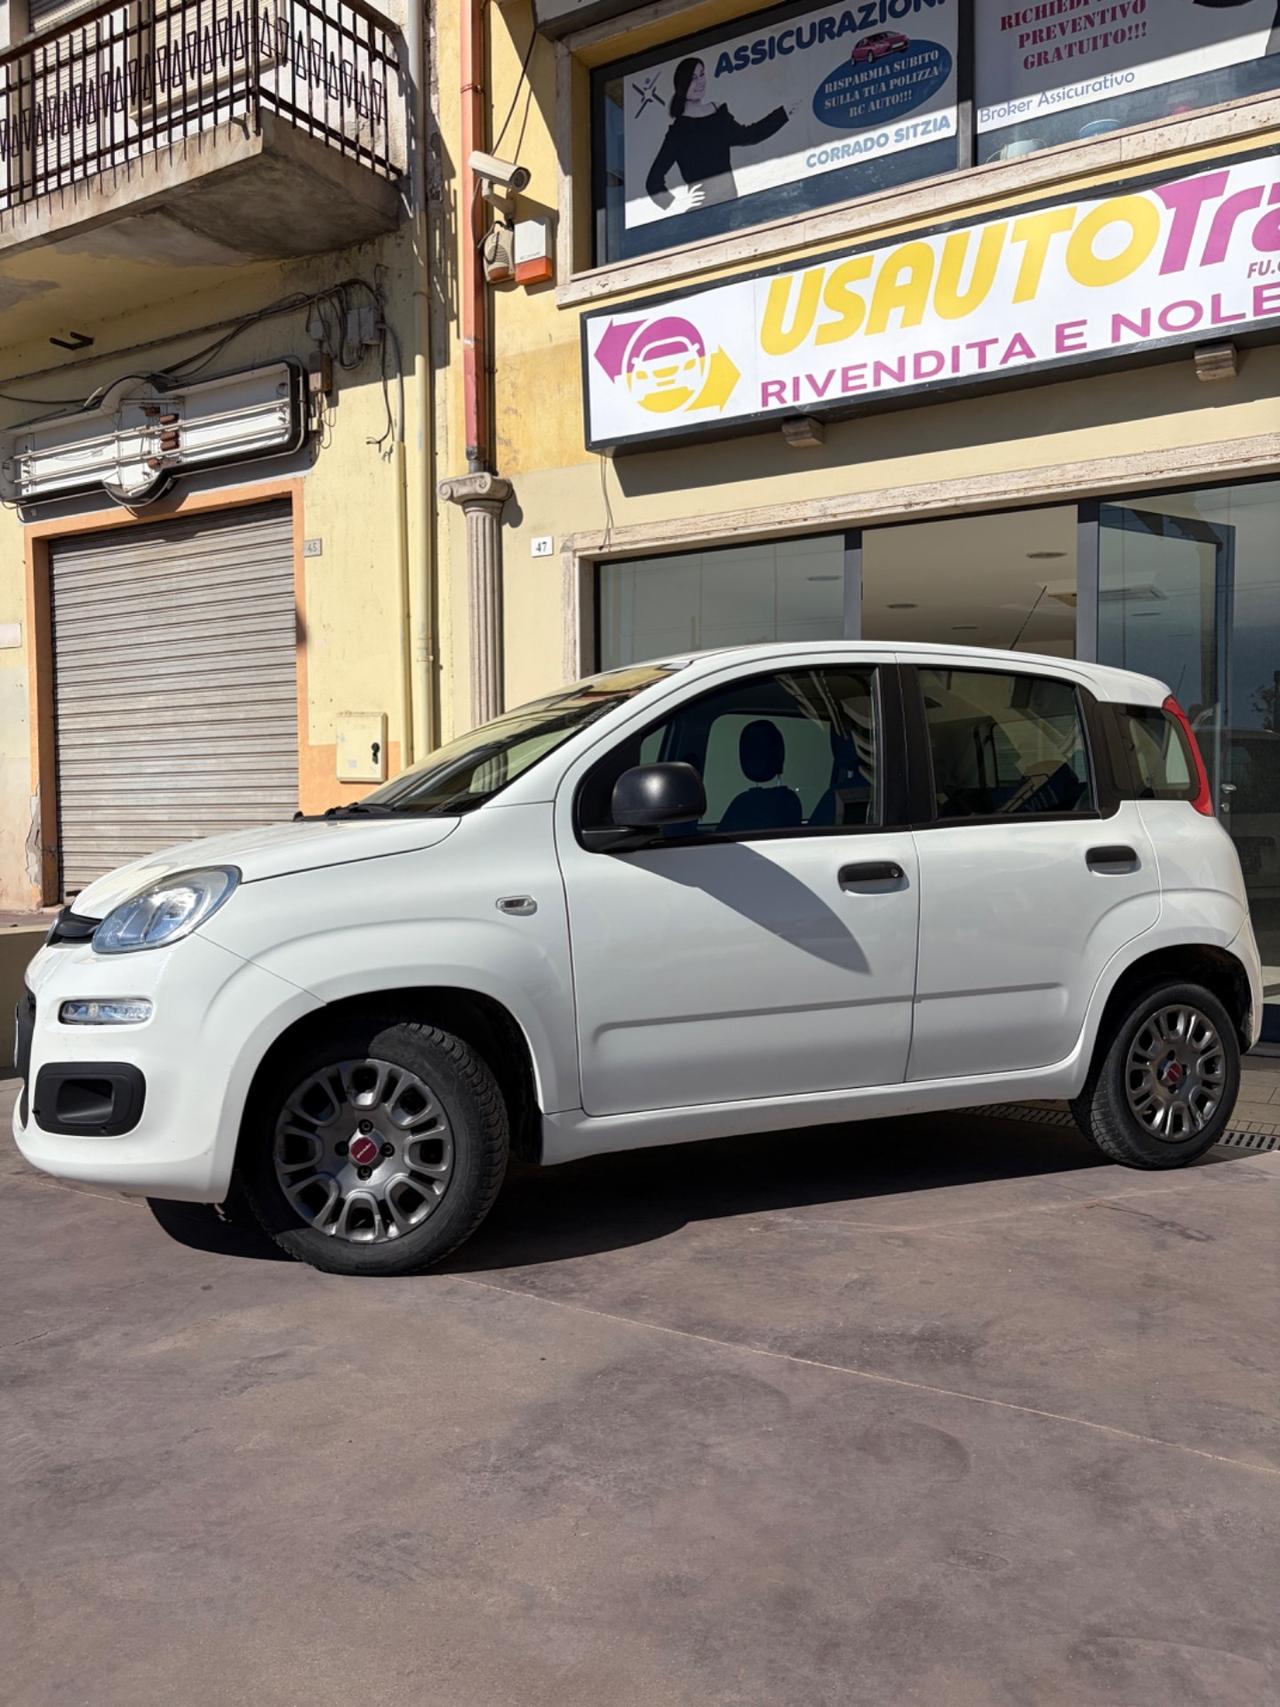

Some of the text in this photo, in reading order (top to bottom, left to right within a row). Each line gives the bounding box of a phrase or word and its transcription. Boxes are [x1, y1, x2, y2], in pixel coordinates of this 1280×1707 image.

[1018, 0, 1147, 49] PREVENTIVO
[1023, 21, 1147, 70] GRATUITO!!!
[824, 66, 939, 109] SULLA TUA POLIZZA
[825, 50, 939, 94] RISPARMIA SUBITO
[849, 89, 912, 118] RC AUTO!!!
[979, 70, 1136, 123] Broker Assicurativo
[806, 115, 951, 168] CORRADO SITZIA
[760, 332, 1036, 408] RIVENDITA
[1055, 319, 1088, 354] E
[308, 542, 318, 553] 45
[536, 541, 547, 552] 47
